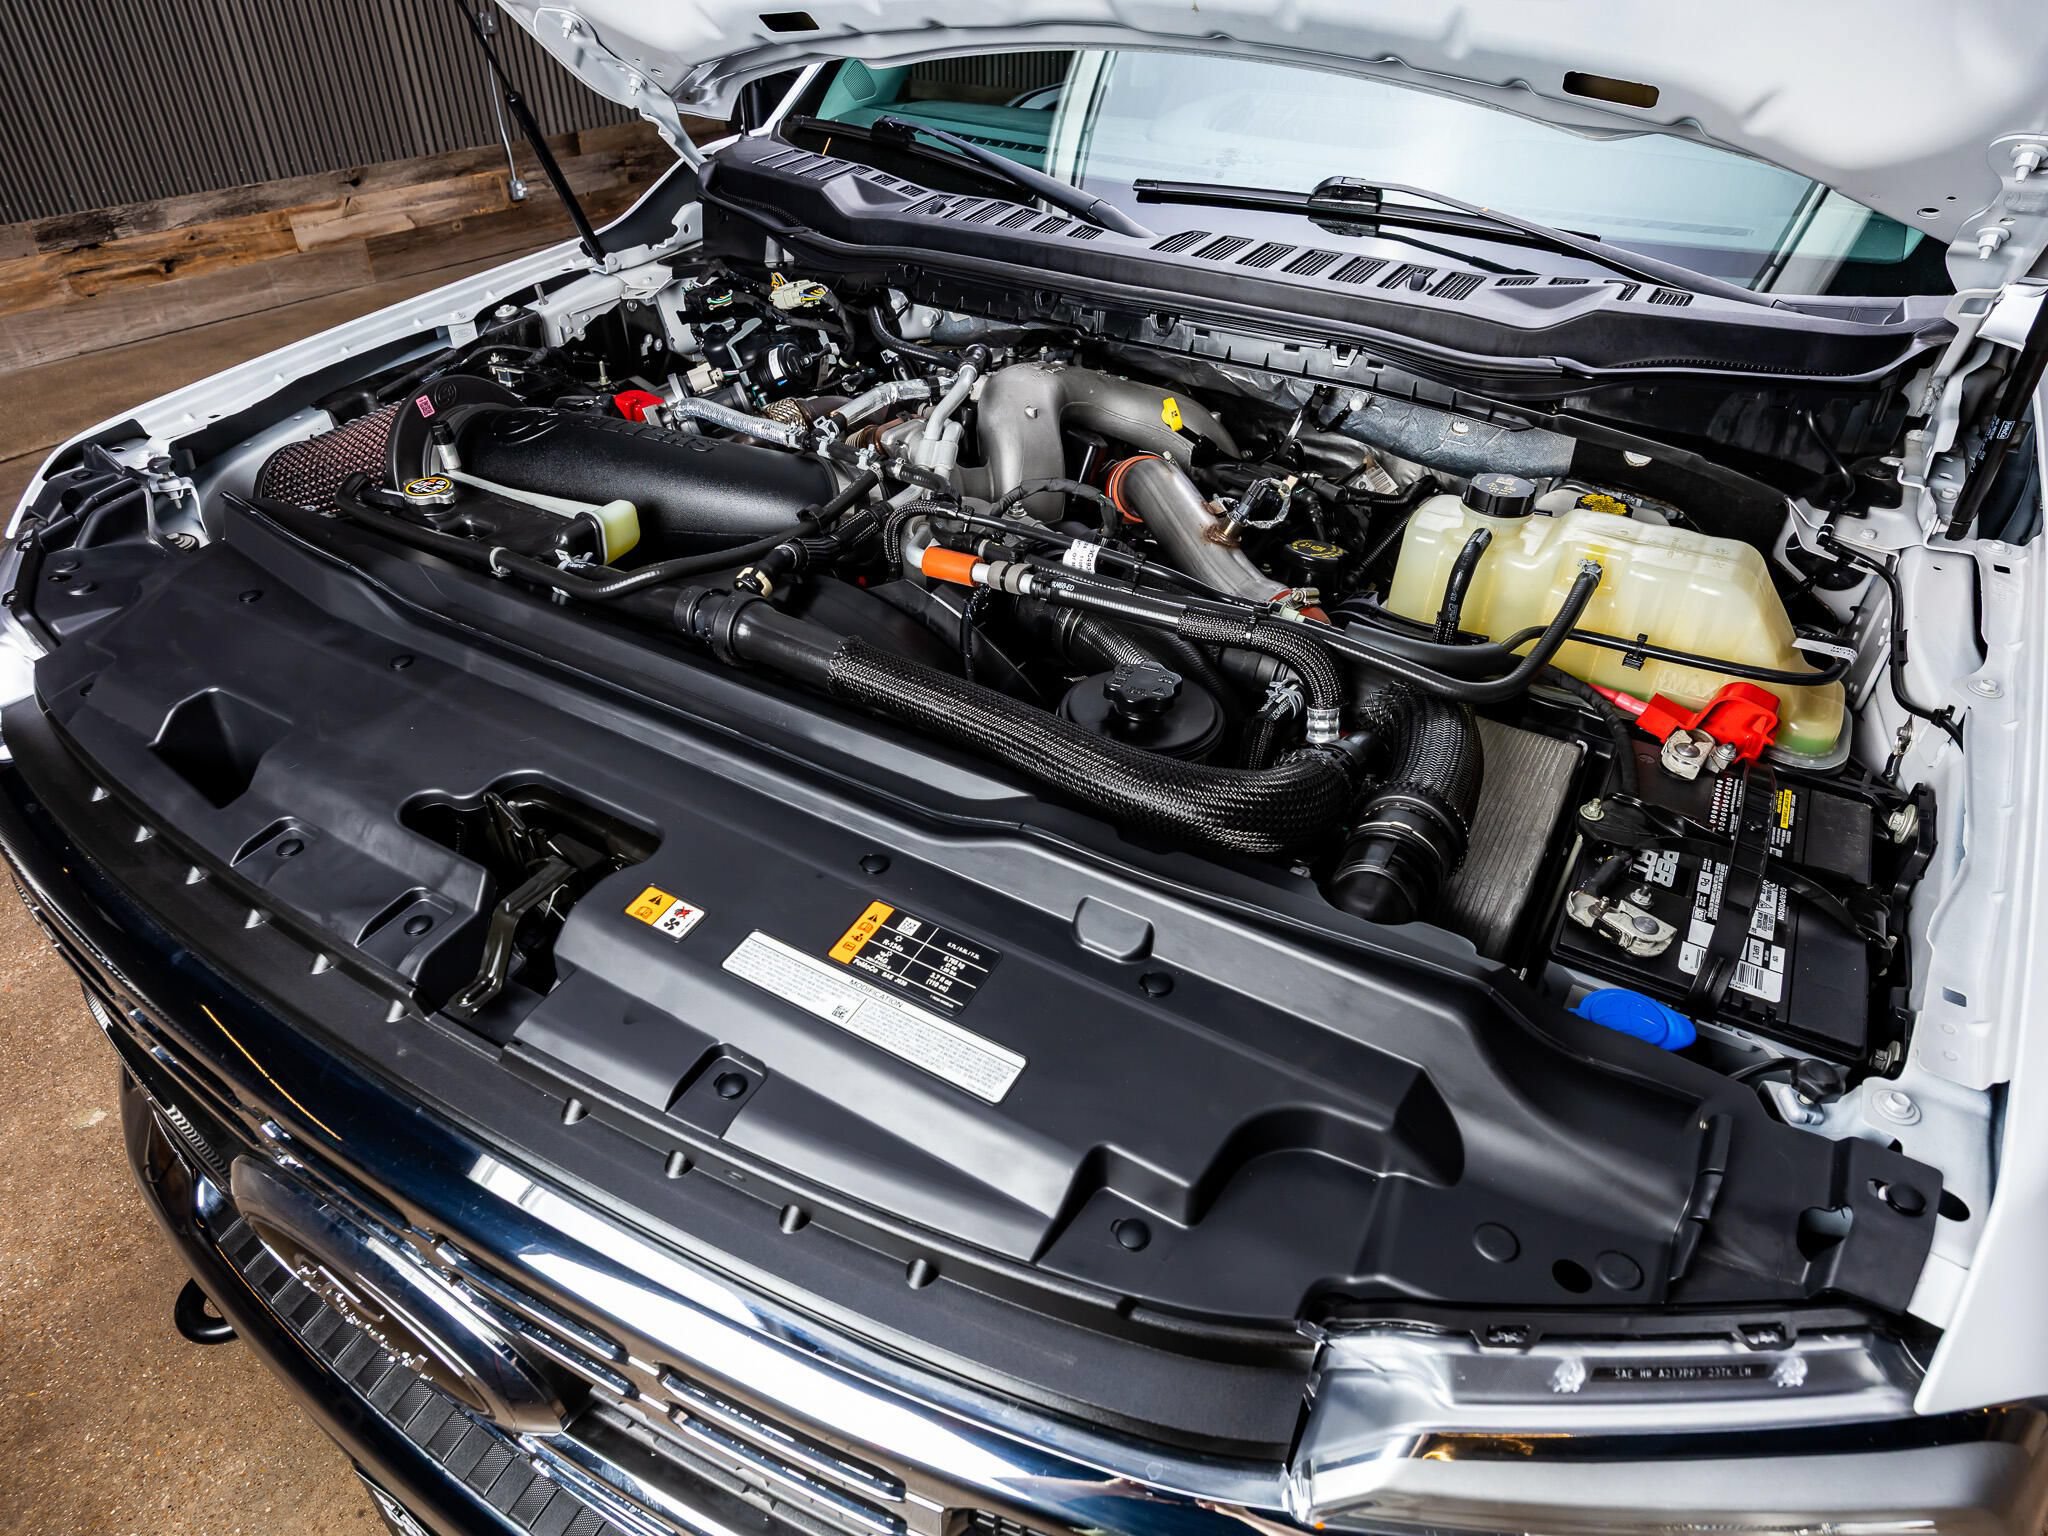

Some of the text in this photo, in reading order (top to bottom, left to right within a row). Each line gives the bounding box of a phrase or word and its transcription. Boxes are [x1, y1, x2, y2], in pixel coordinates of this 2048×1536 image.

[1652, 850, 1680, 888] PER
[1776, 886, 1788, 921] GER/POISON
[882, 939, 904, 952] R-134a
[853, 958, 878, 973] FoMoCo
[881, 971, 895, 980] SAE
[850, 979, 904, 1008] MODIFICATION
[1614, 1367, 1633, 1380] SAE
